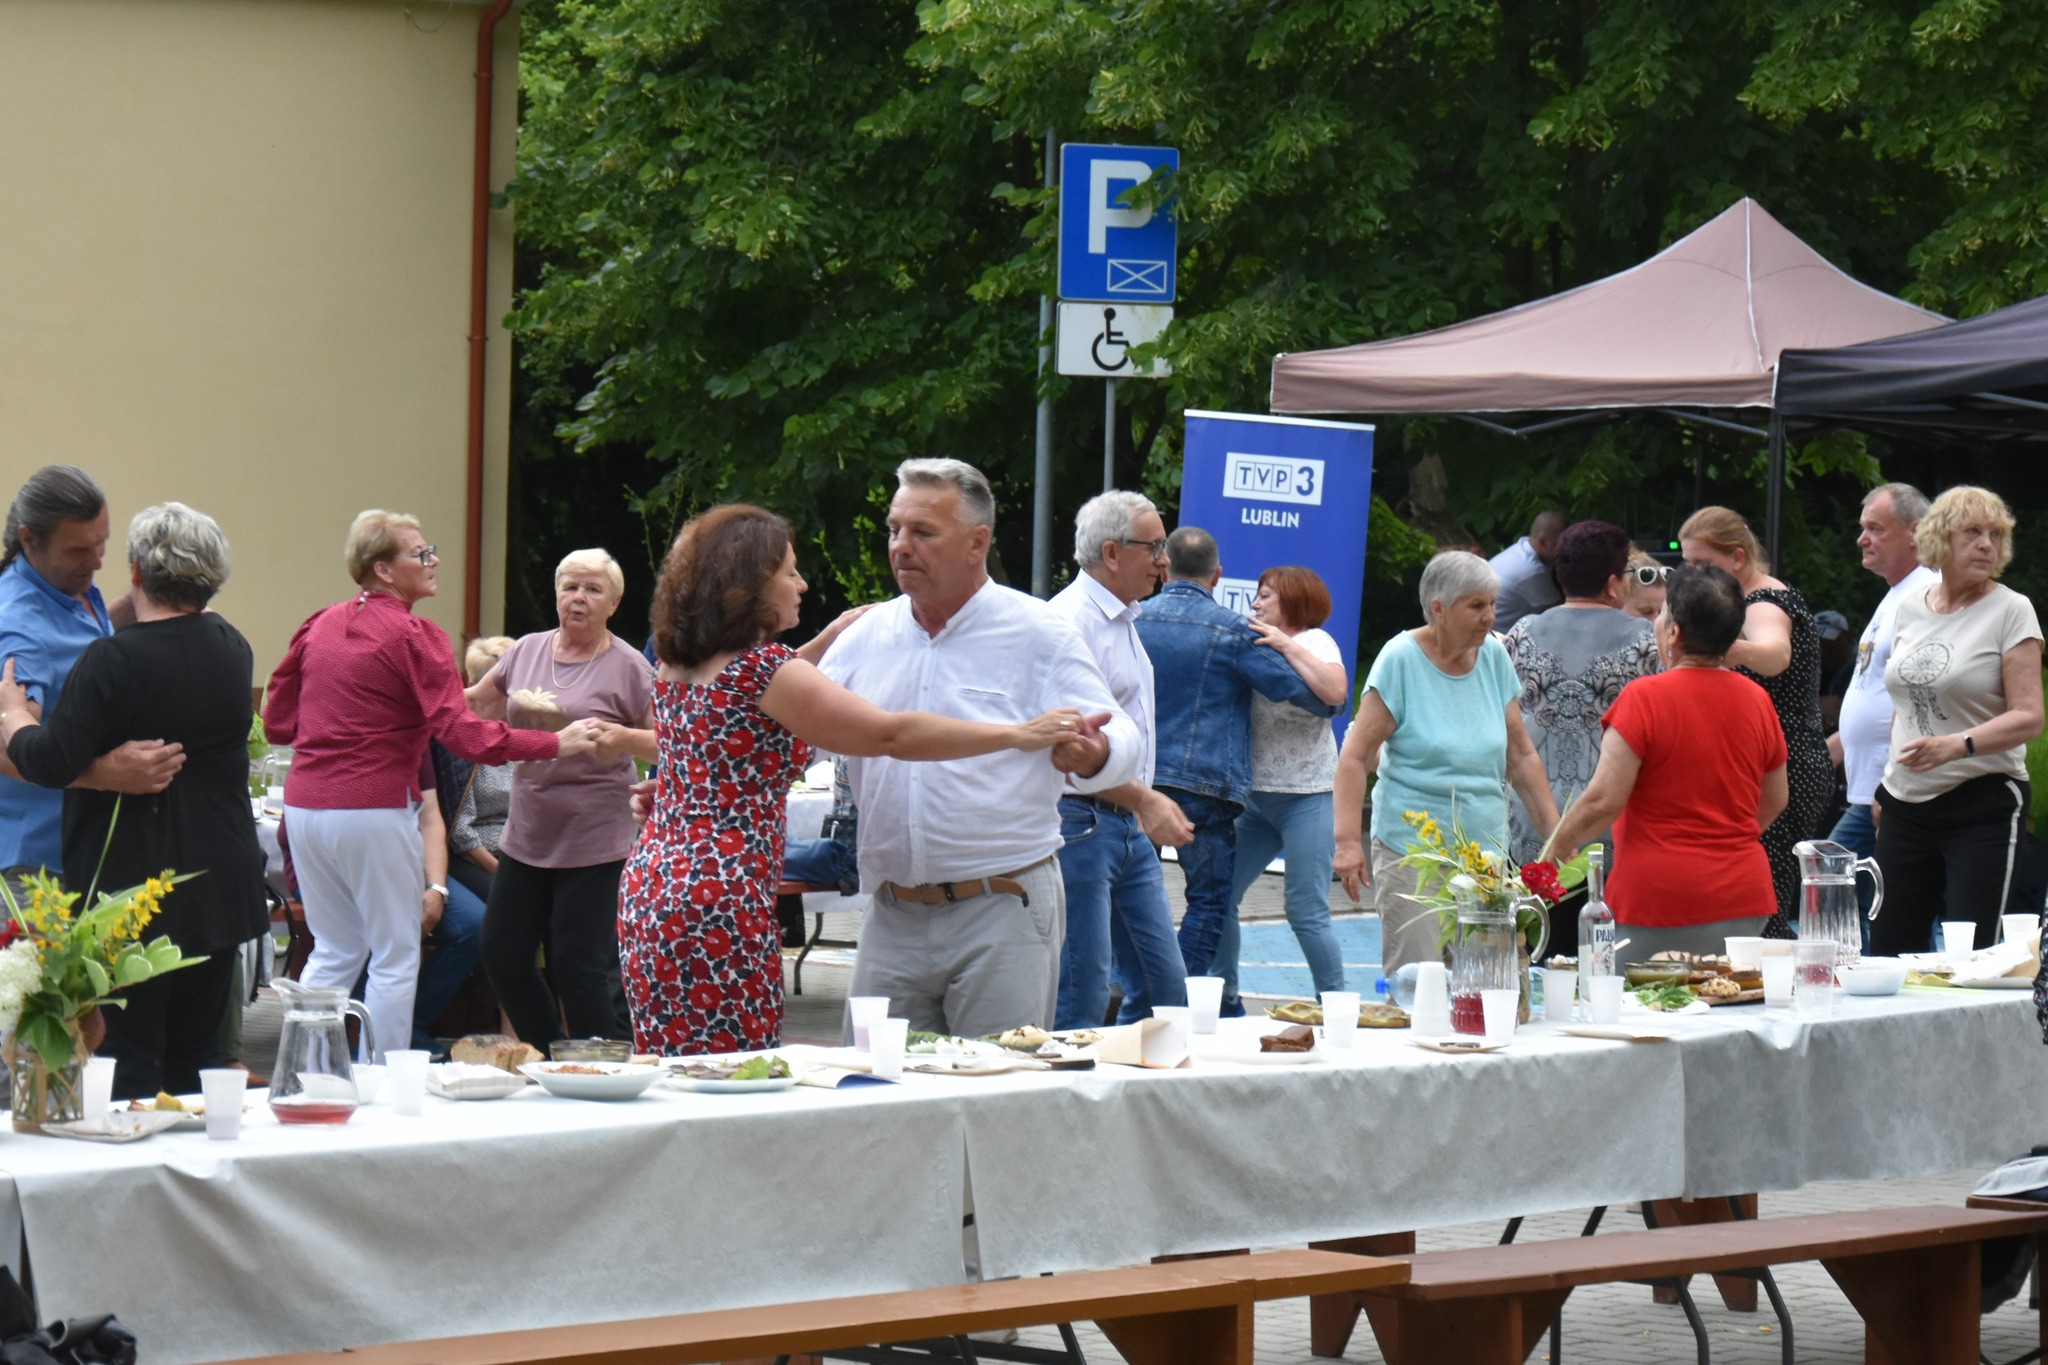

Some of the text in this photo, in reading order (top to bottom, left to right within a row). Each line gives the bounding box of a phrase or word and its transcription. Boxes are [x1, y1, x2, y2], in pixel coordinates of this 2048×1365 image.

[1088, 159, 1154, 254] P
[1241, 508, 1300, 529] LUBLIN
[1227, 591, 1258, 610] TV
